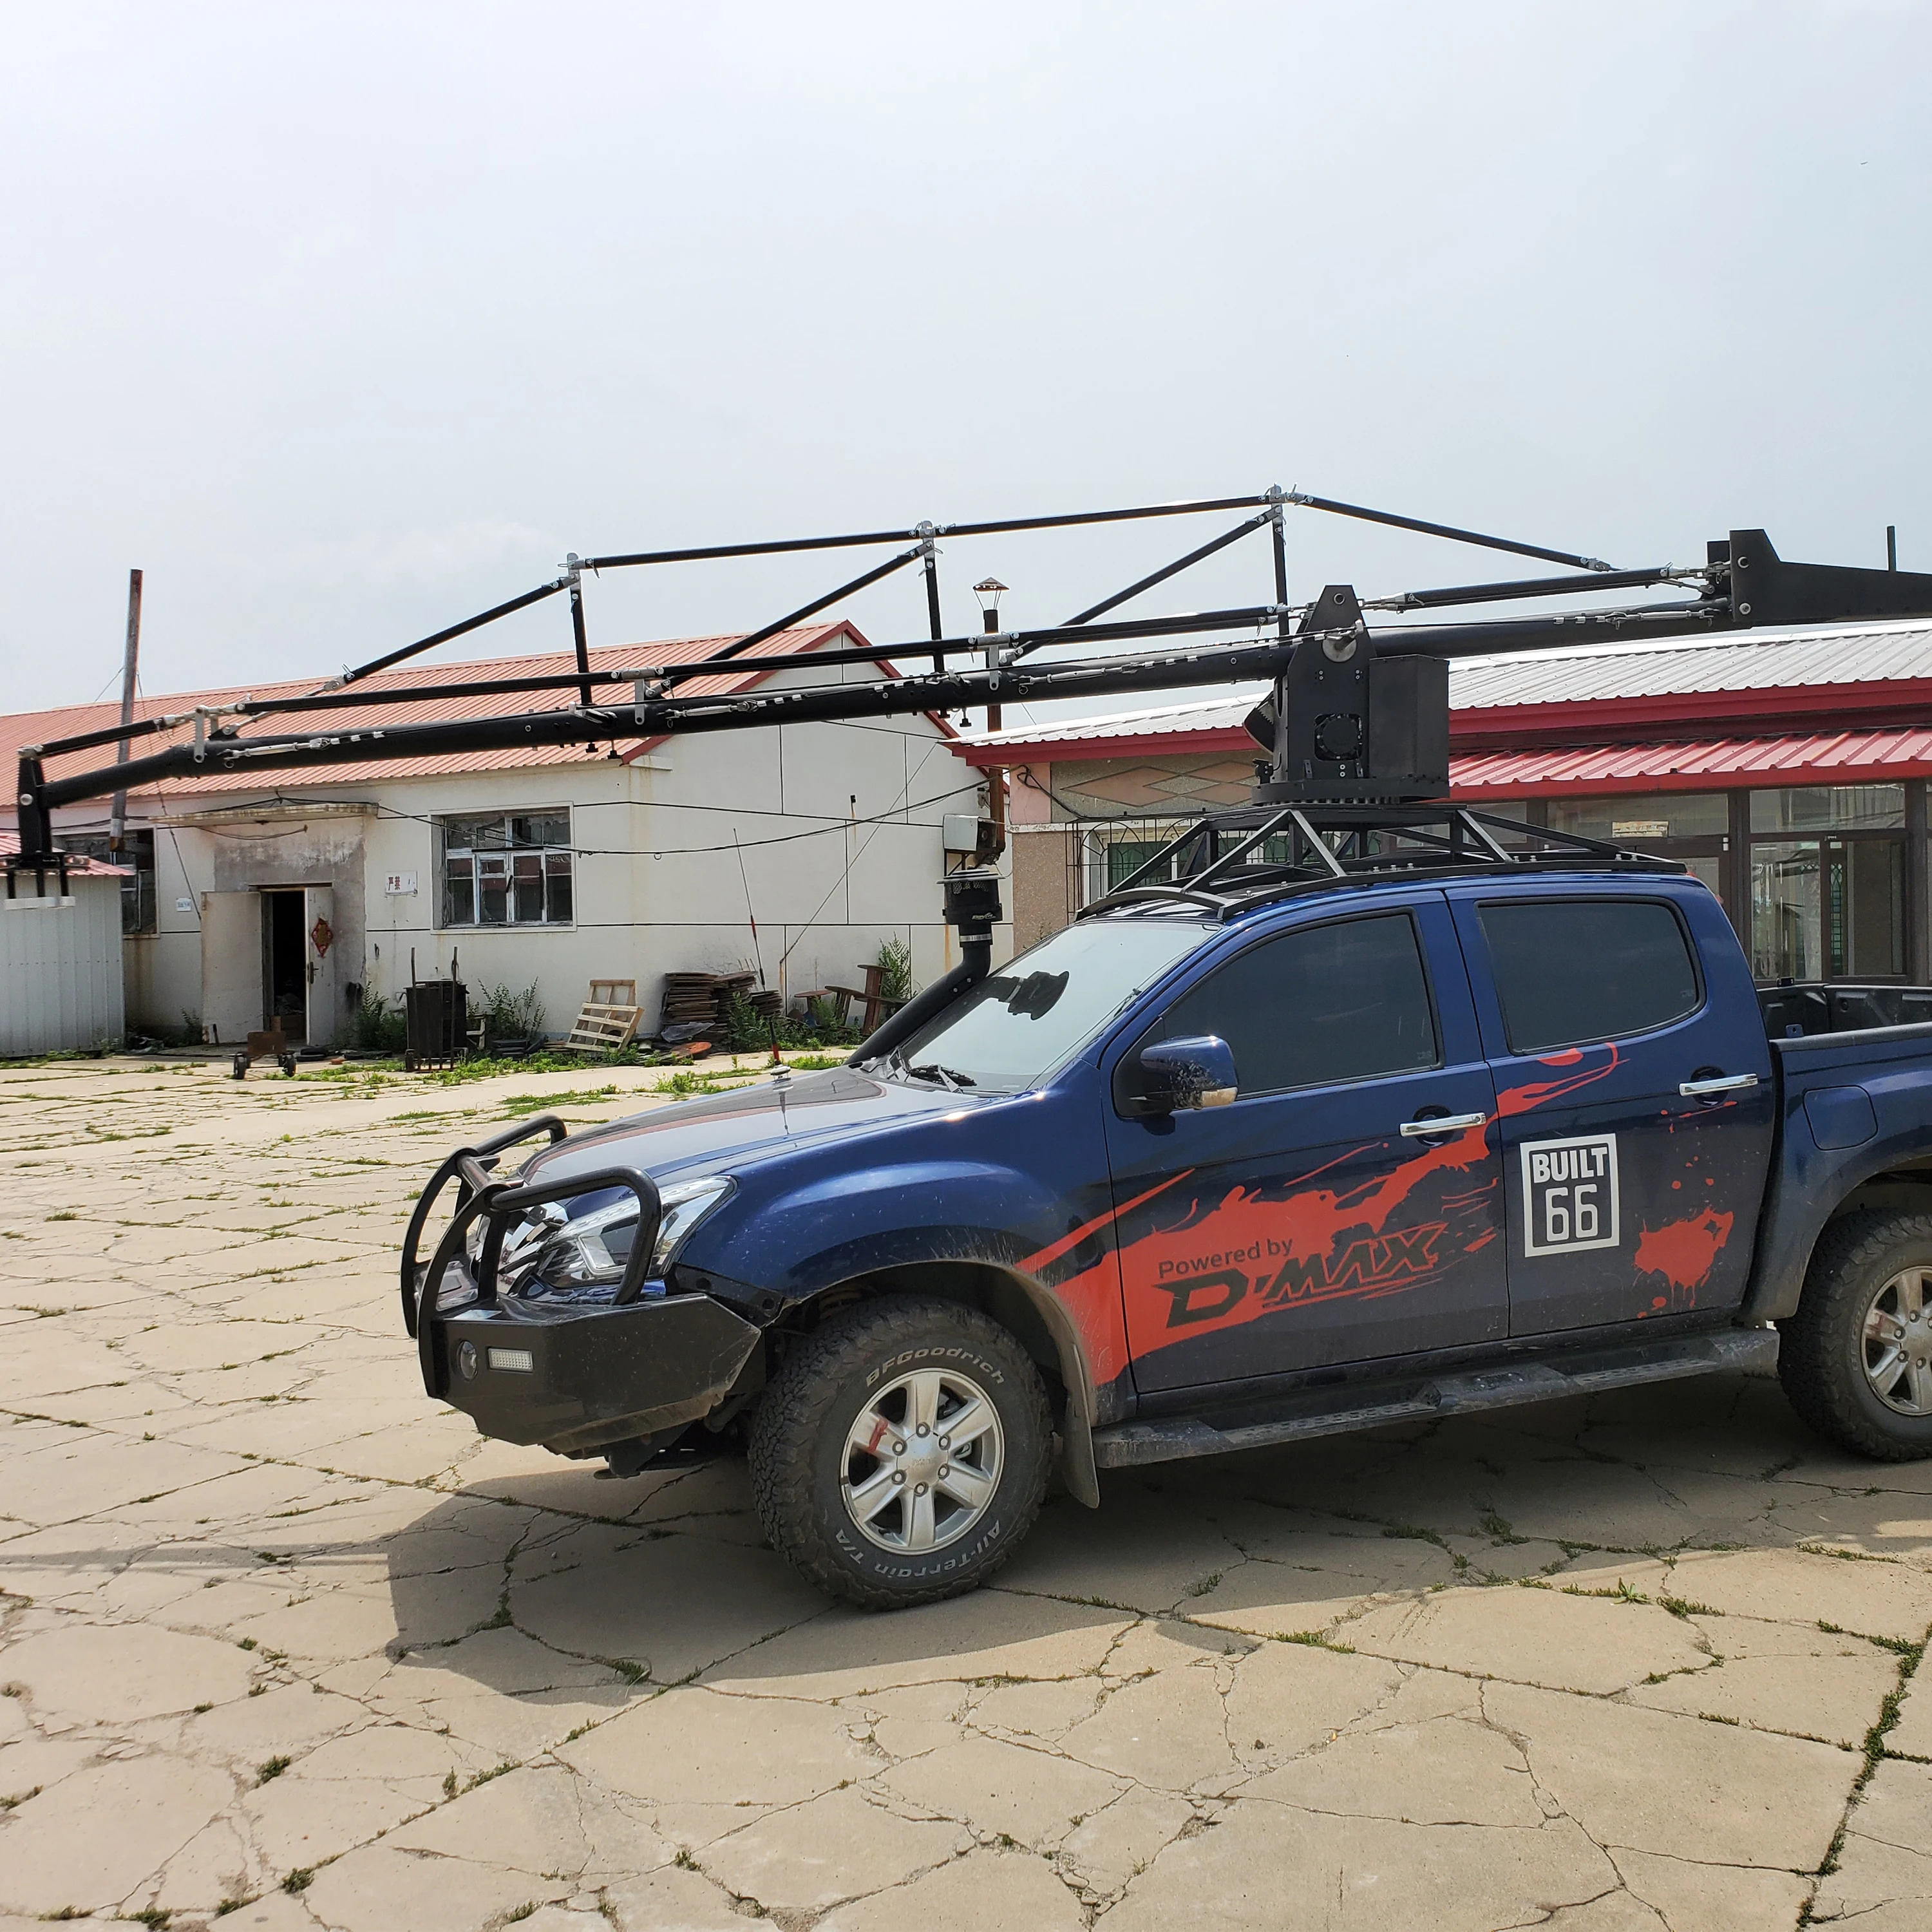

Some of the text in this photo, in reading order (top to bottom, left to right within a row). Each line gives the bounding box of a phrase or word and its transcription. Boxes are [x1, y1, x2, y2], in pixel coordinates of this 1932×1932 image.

[1531, 1146, 1608, 1184] BUILT
[1545, 1184, 1598, 1242] 66
[1159, 1238, 1293, 1278] Powered by
[866, 1347, 1005, 1387] BFGoodrich
[835, 1519, 1001, 1578] All-Terrain T/A
